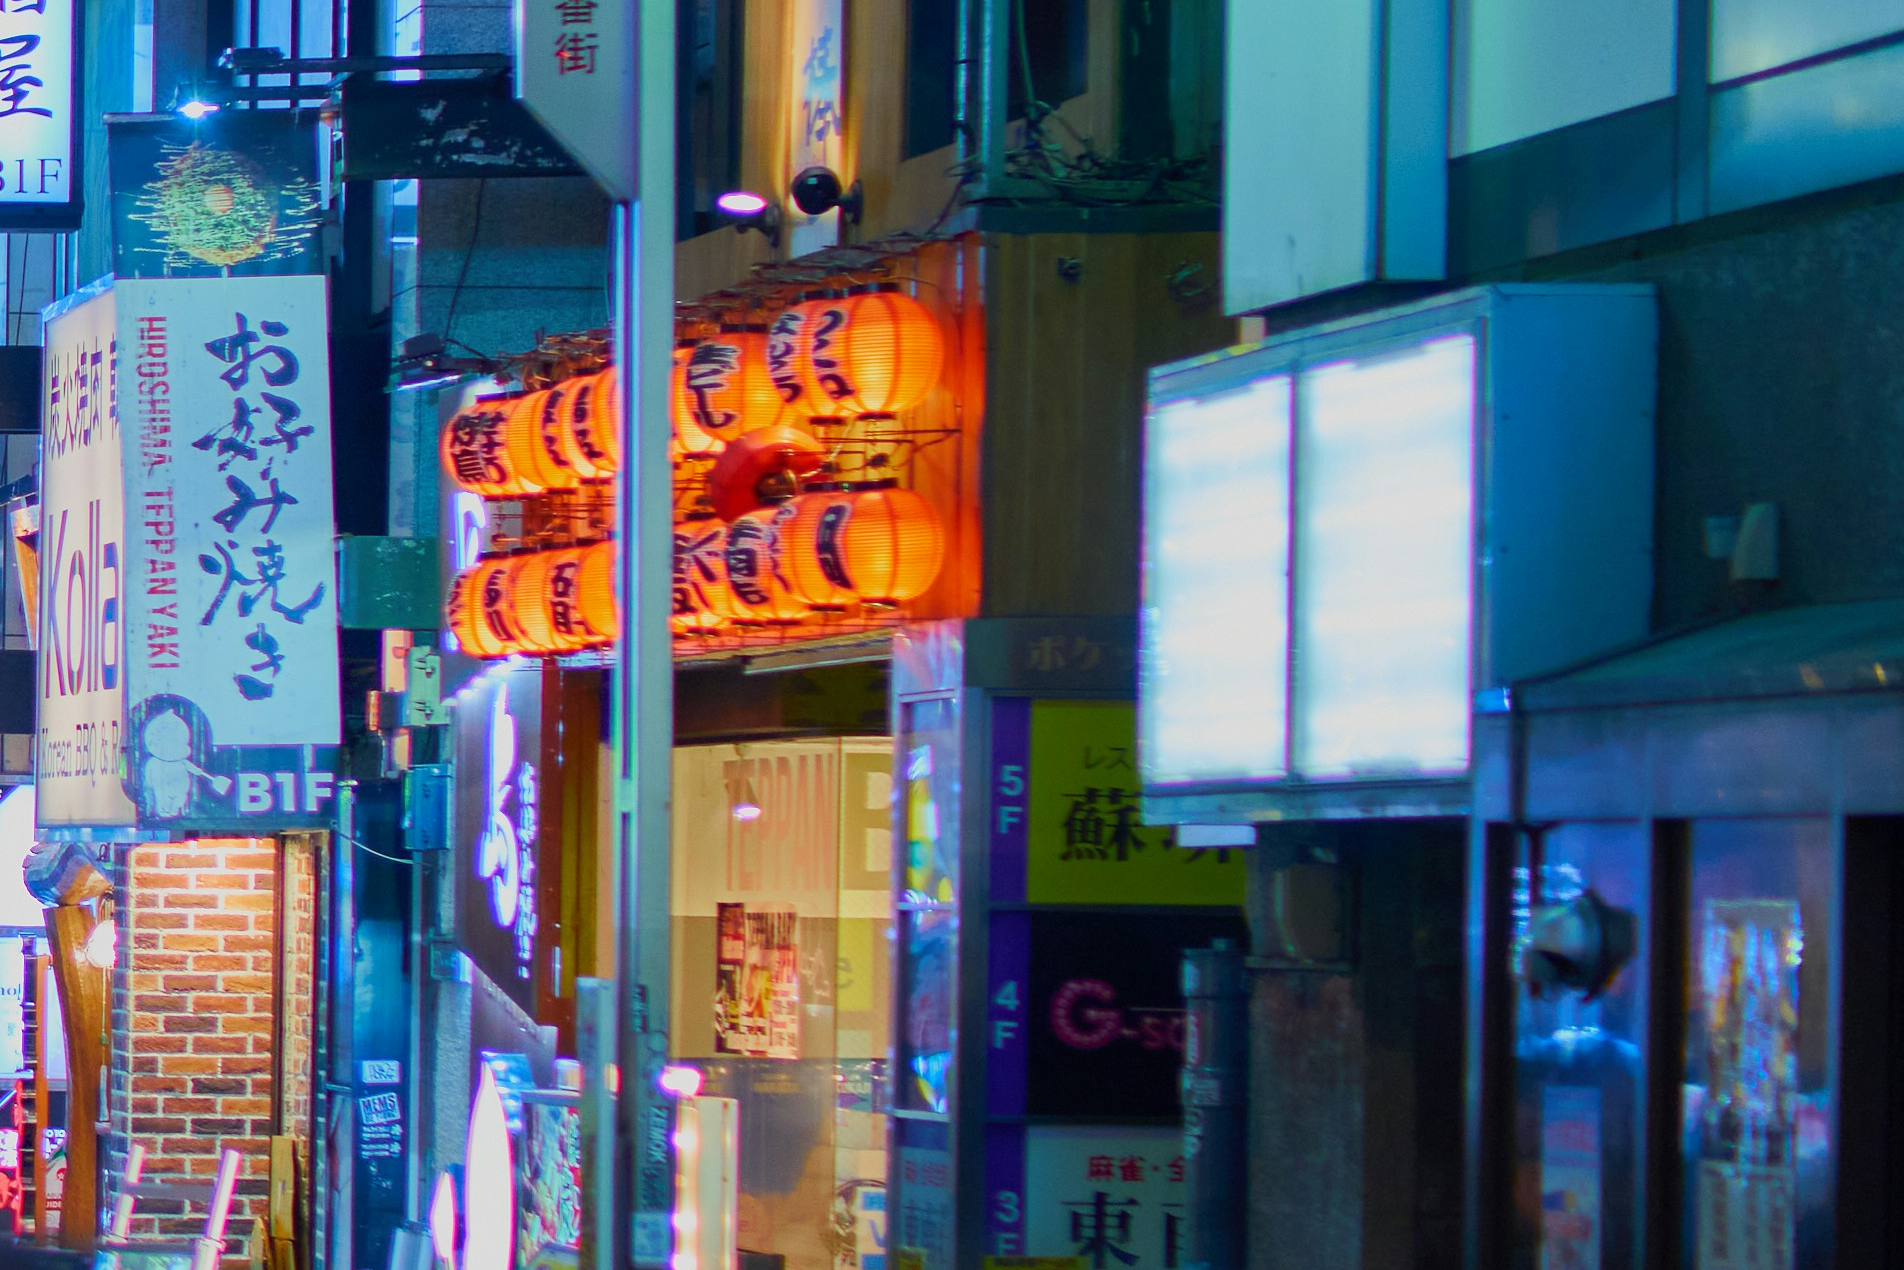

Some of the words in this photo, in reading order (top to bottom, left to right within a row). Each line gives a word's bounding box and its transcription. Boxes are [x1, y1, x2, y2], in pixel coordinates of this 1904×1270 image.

[136, 315, 174, 469] HIROSHIMA
[191, 311, 326, 701] お好み焼き
[238, 772, 336, 813] B1F
[998, 766, 1024, 834] 5F
[992, 979, 1020, 1049] 4F
